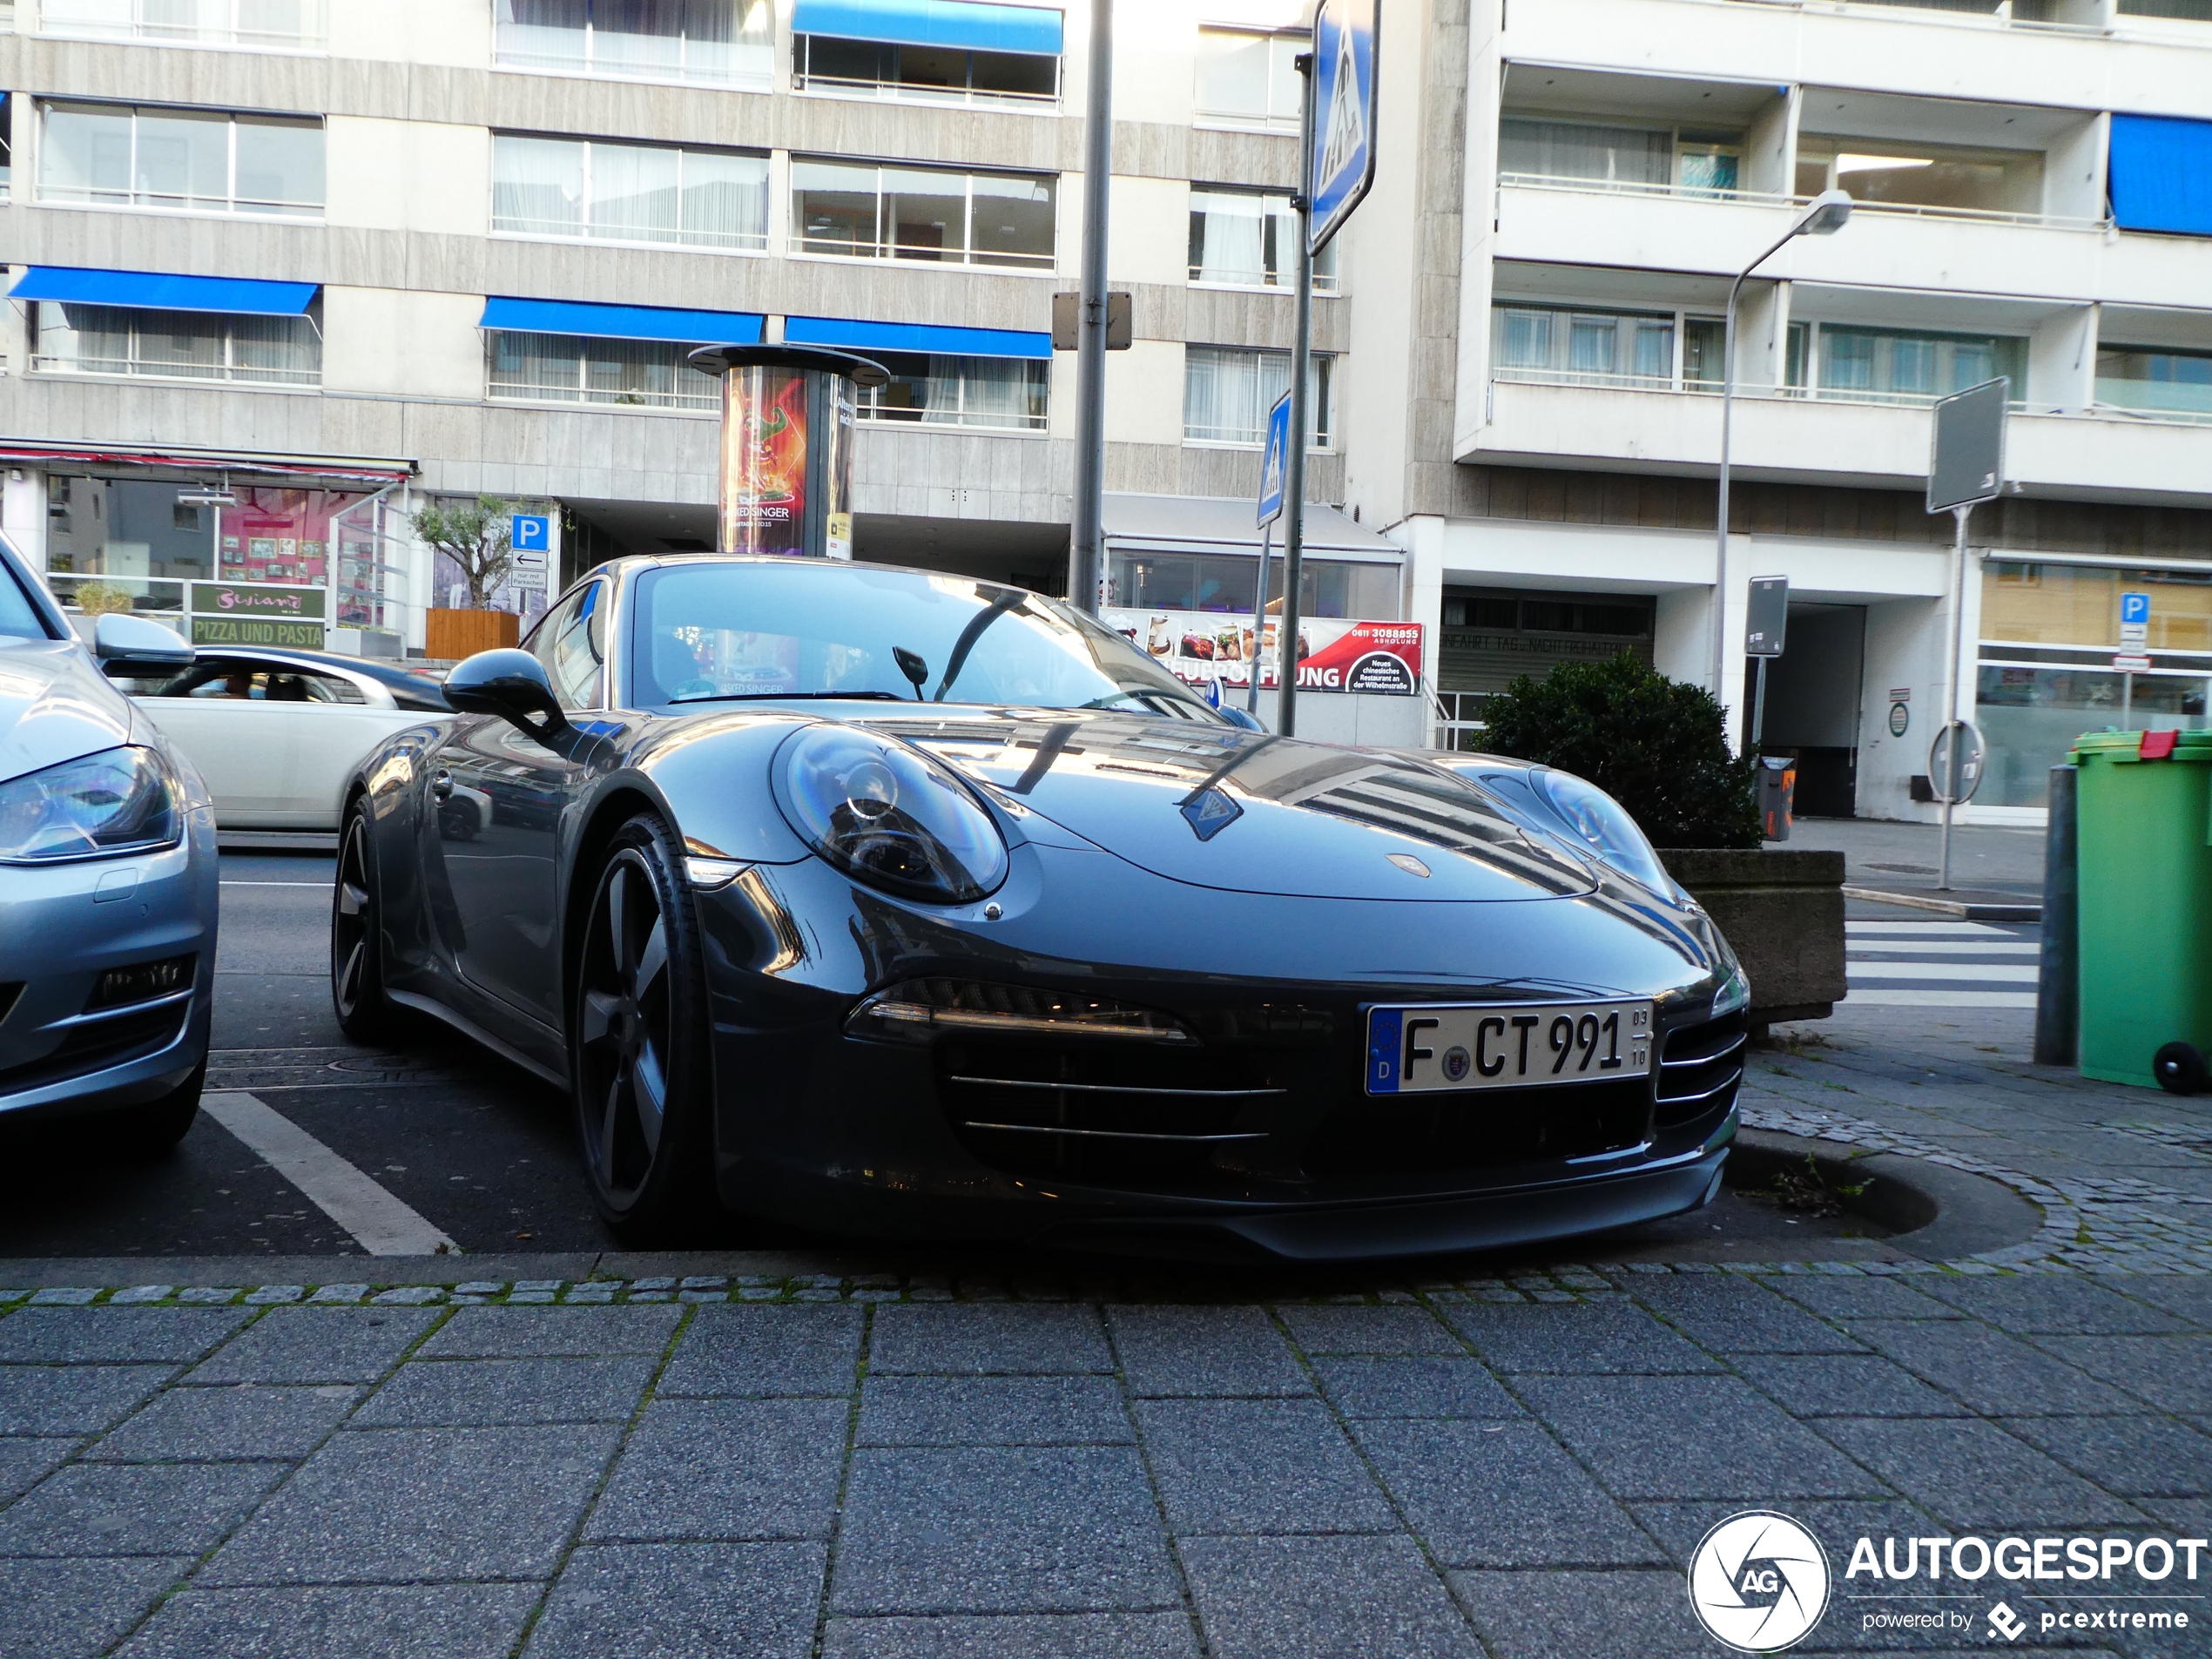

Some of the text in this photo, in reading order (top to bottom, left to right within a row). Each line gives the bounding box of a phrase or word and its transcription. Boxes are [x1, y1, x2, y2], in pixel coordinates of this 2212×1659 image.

[752, 507, 789, 518] SINGER
[520, 519, 540, 546] P
[2127, 597, 2143, 619] P
[194, 620, 323, 644] PIZZA UND PASTA
[1372, 629, 1419, 638] 3088855
[1440, 634, 1490, 650] INFAHRT
[1163, 660, 1340, 688] EUERÖFUNG
[1362, 666, 1399, 675] chinesisches
[746, 684, 784, 694] SINGER
[1365, 681, 1407, 690] Wilhelmstraße
[1633, 1008, 1648, 1025] 03
[1404, 1010, 1622, 1080] F CT 991
[1632, 1049, 1646, 1066] 10
[1379, 1062, 1389, 1079] D
